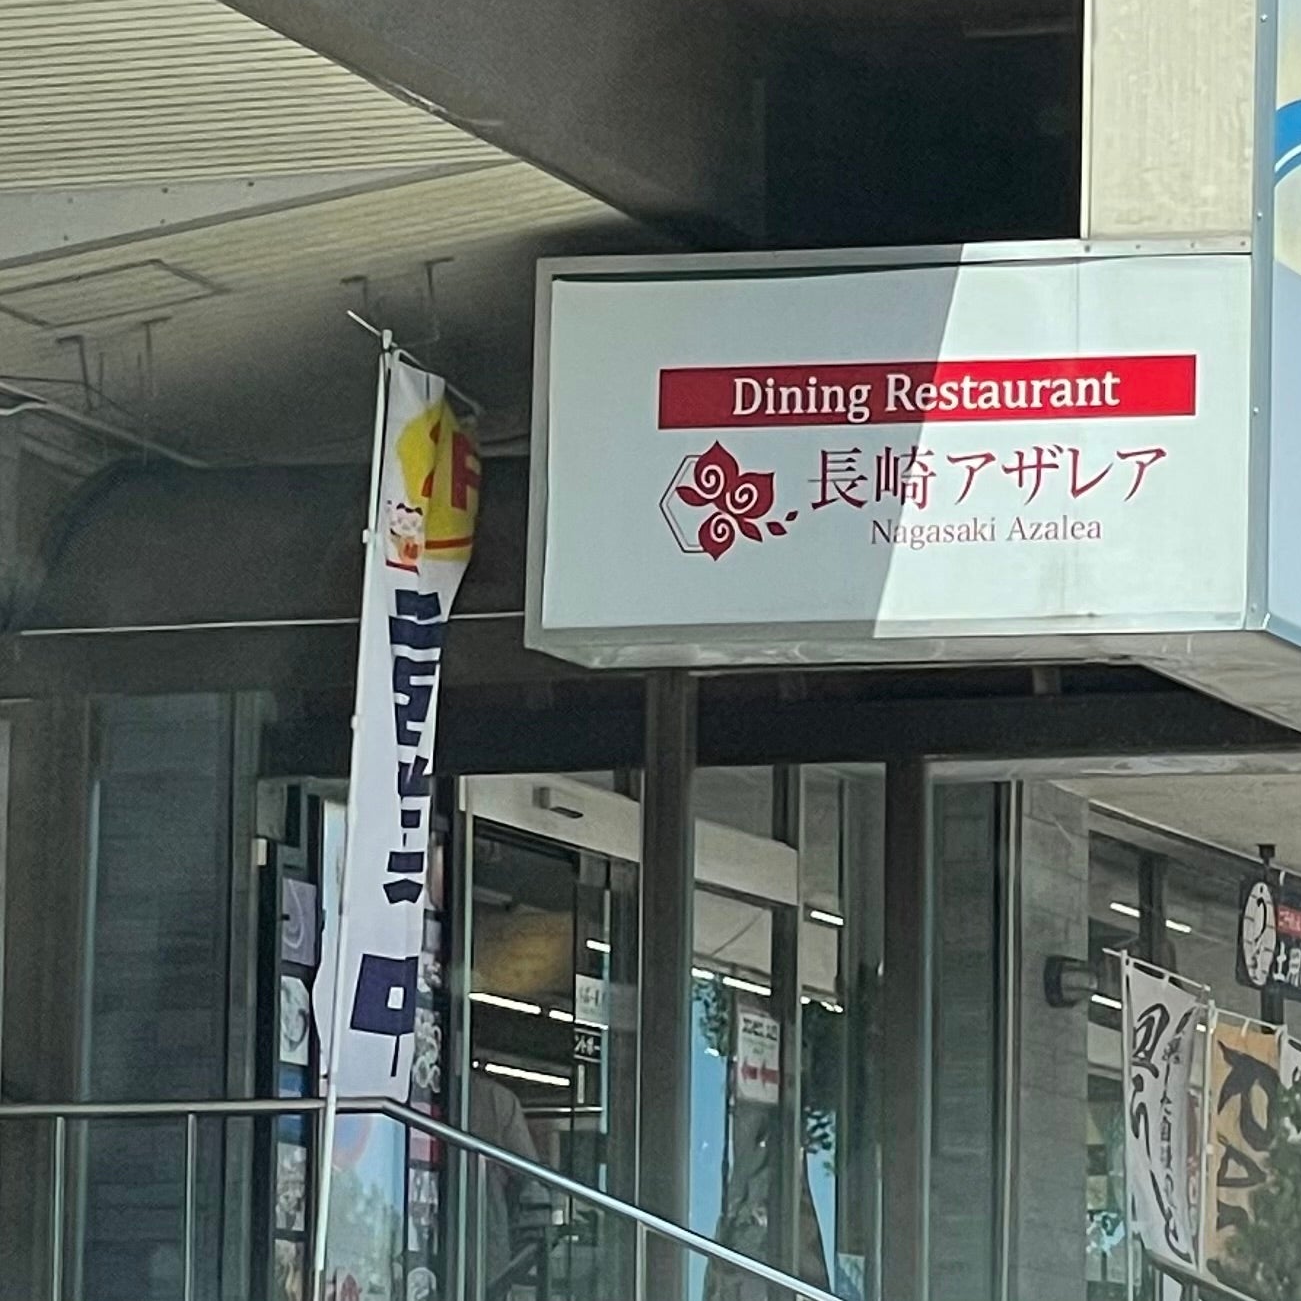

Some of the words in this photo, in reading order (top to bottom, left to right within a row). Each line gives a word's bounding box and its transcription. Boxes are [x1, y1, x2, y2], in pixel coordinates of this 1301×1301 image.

[732, 376, 871, 422] Dining
[885, 372, 1120, 411] Restaurant
[808, 443, 1167, 510] 長崎アザレア
[870, 516, 996, 550] Nagasaki
[1006, 514, 1102, 541] Azalea
